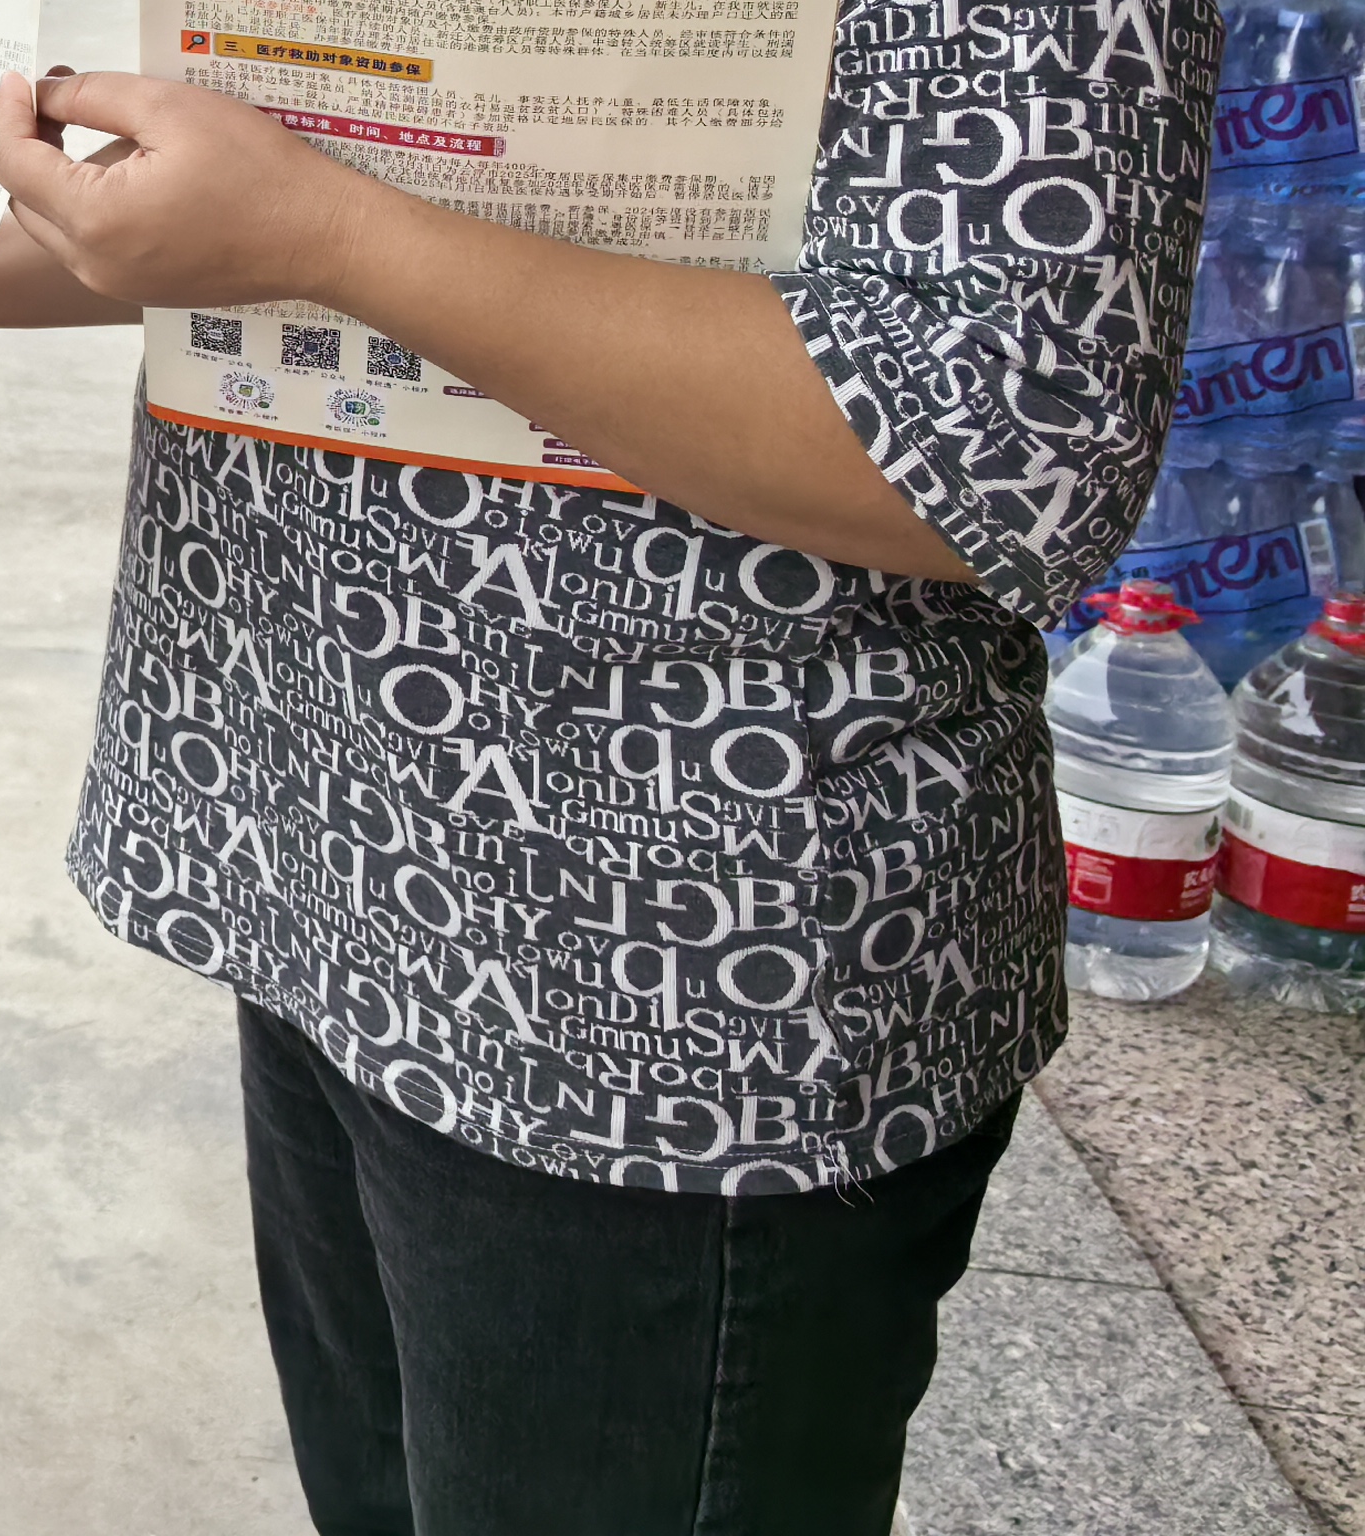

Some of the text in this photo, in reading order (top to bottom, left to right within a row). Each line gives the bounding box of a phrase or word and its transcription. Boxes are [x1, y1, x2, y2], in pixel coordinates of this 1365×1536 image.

[222, 40, 422, 76] 三、医疗救助对象资助参保
